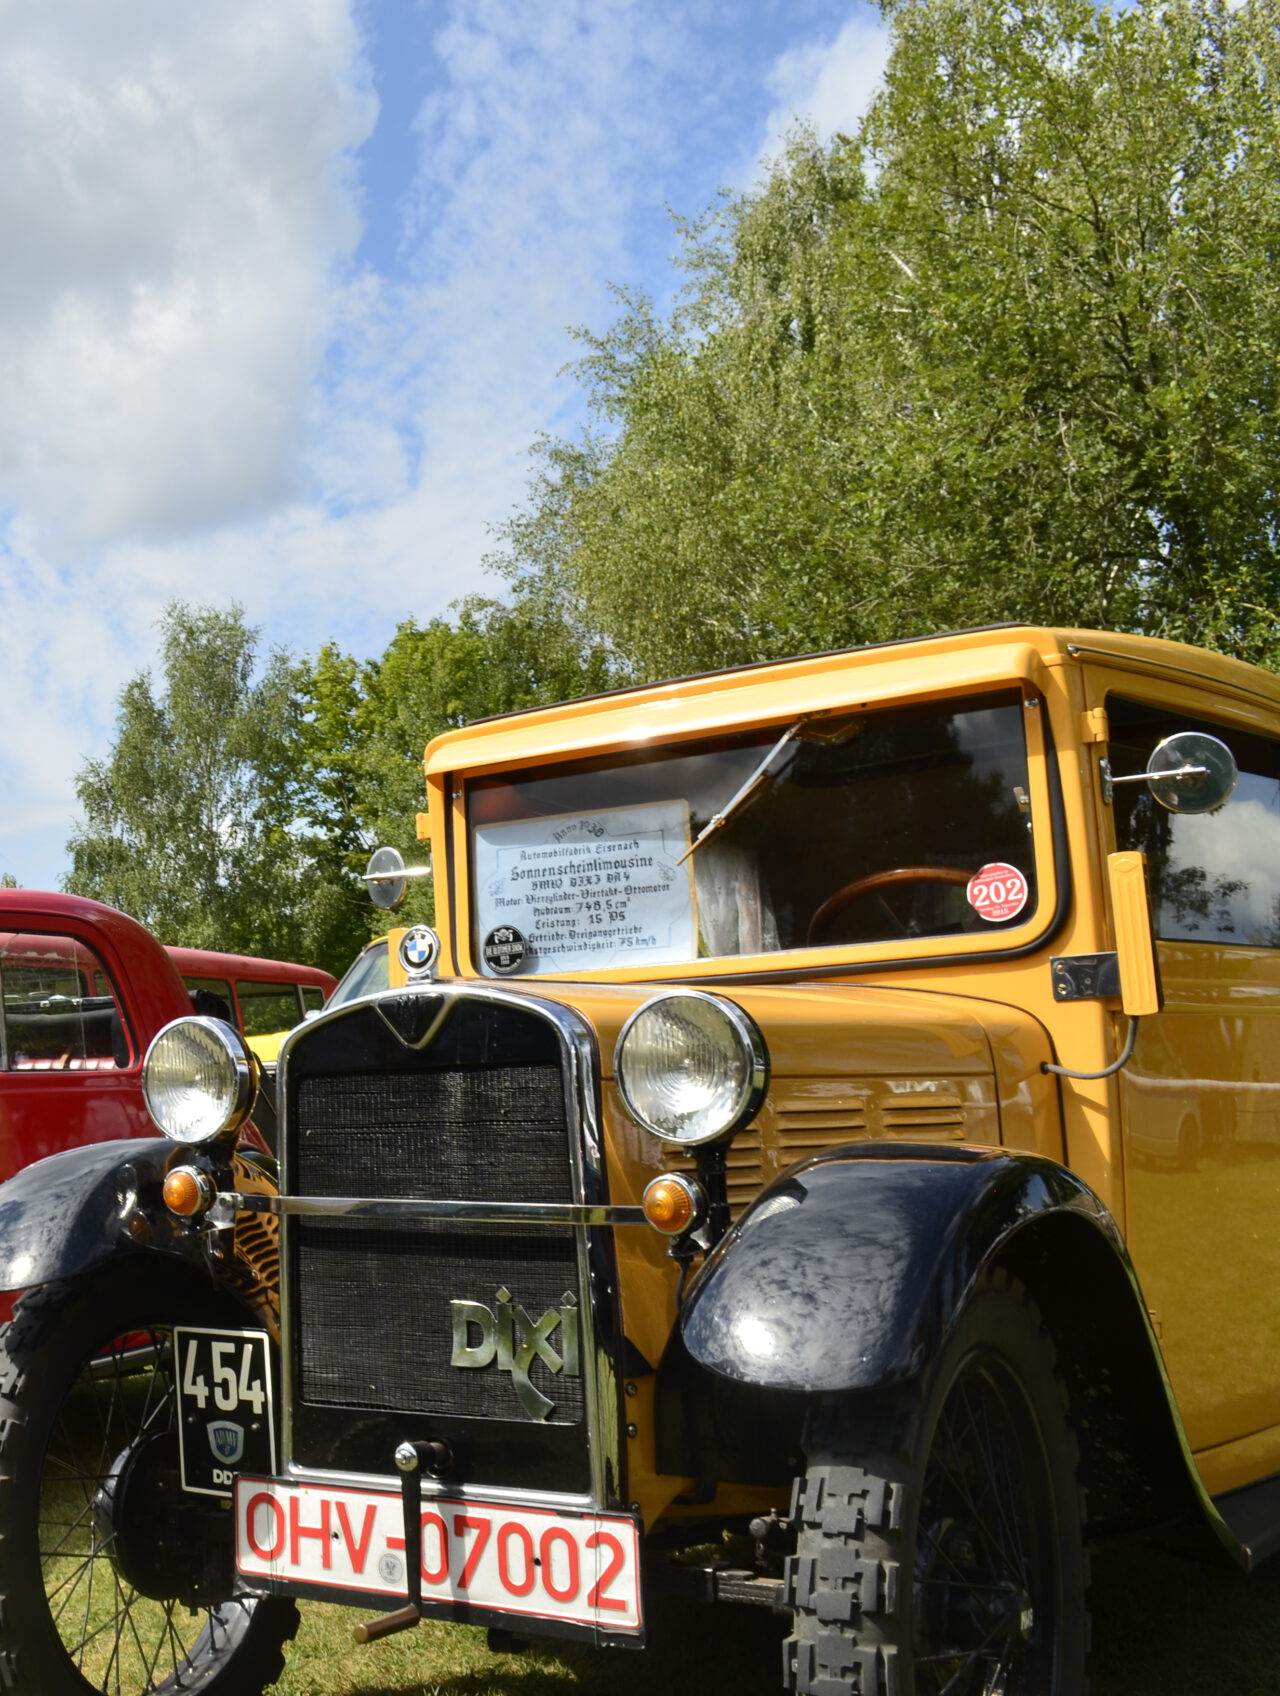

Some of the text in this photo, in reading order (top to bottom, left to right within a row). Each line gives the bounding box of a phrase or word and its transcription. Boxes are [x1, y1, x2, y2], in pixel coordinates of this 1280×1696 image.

[520, 839, 640, 861] Automobilfabrik Eisenach
[510, 856, 653, 881] Sonnenscheinlimousine
[531, 879, 563, 891] BMW
[973, 878, 1023, 906] 202
[588, 913, 603, 925] 15
[609, 910, 626, 923] PS
[618, 936, 634, 947] 75
[183, 1339, 265, 1414] 454
[212, 1468, 240, 1485] DD
